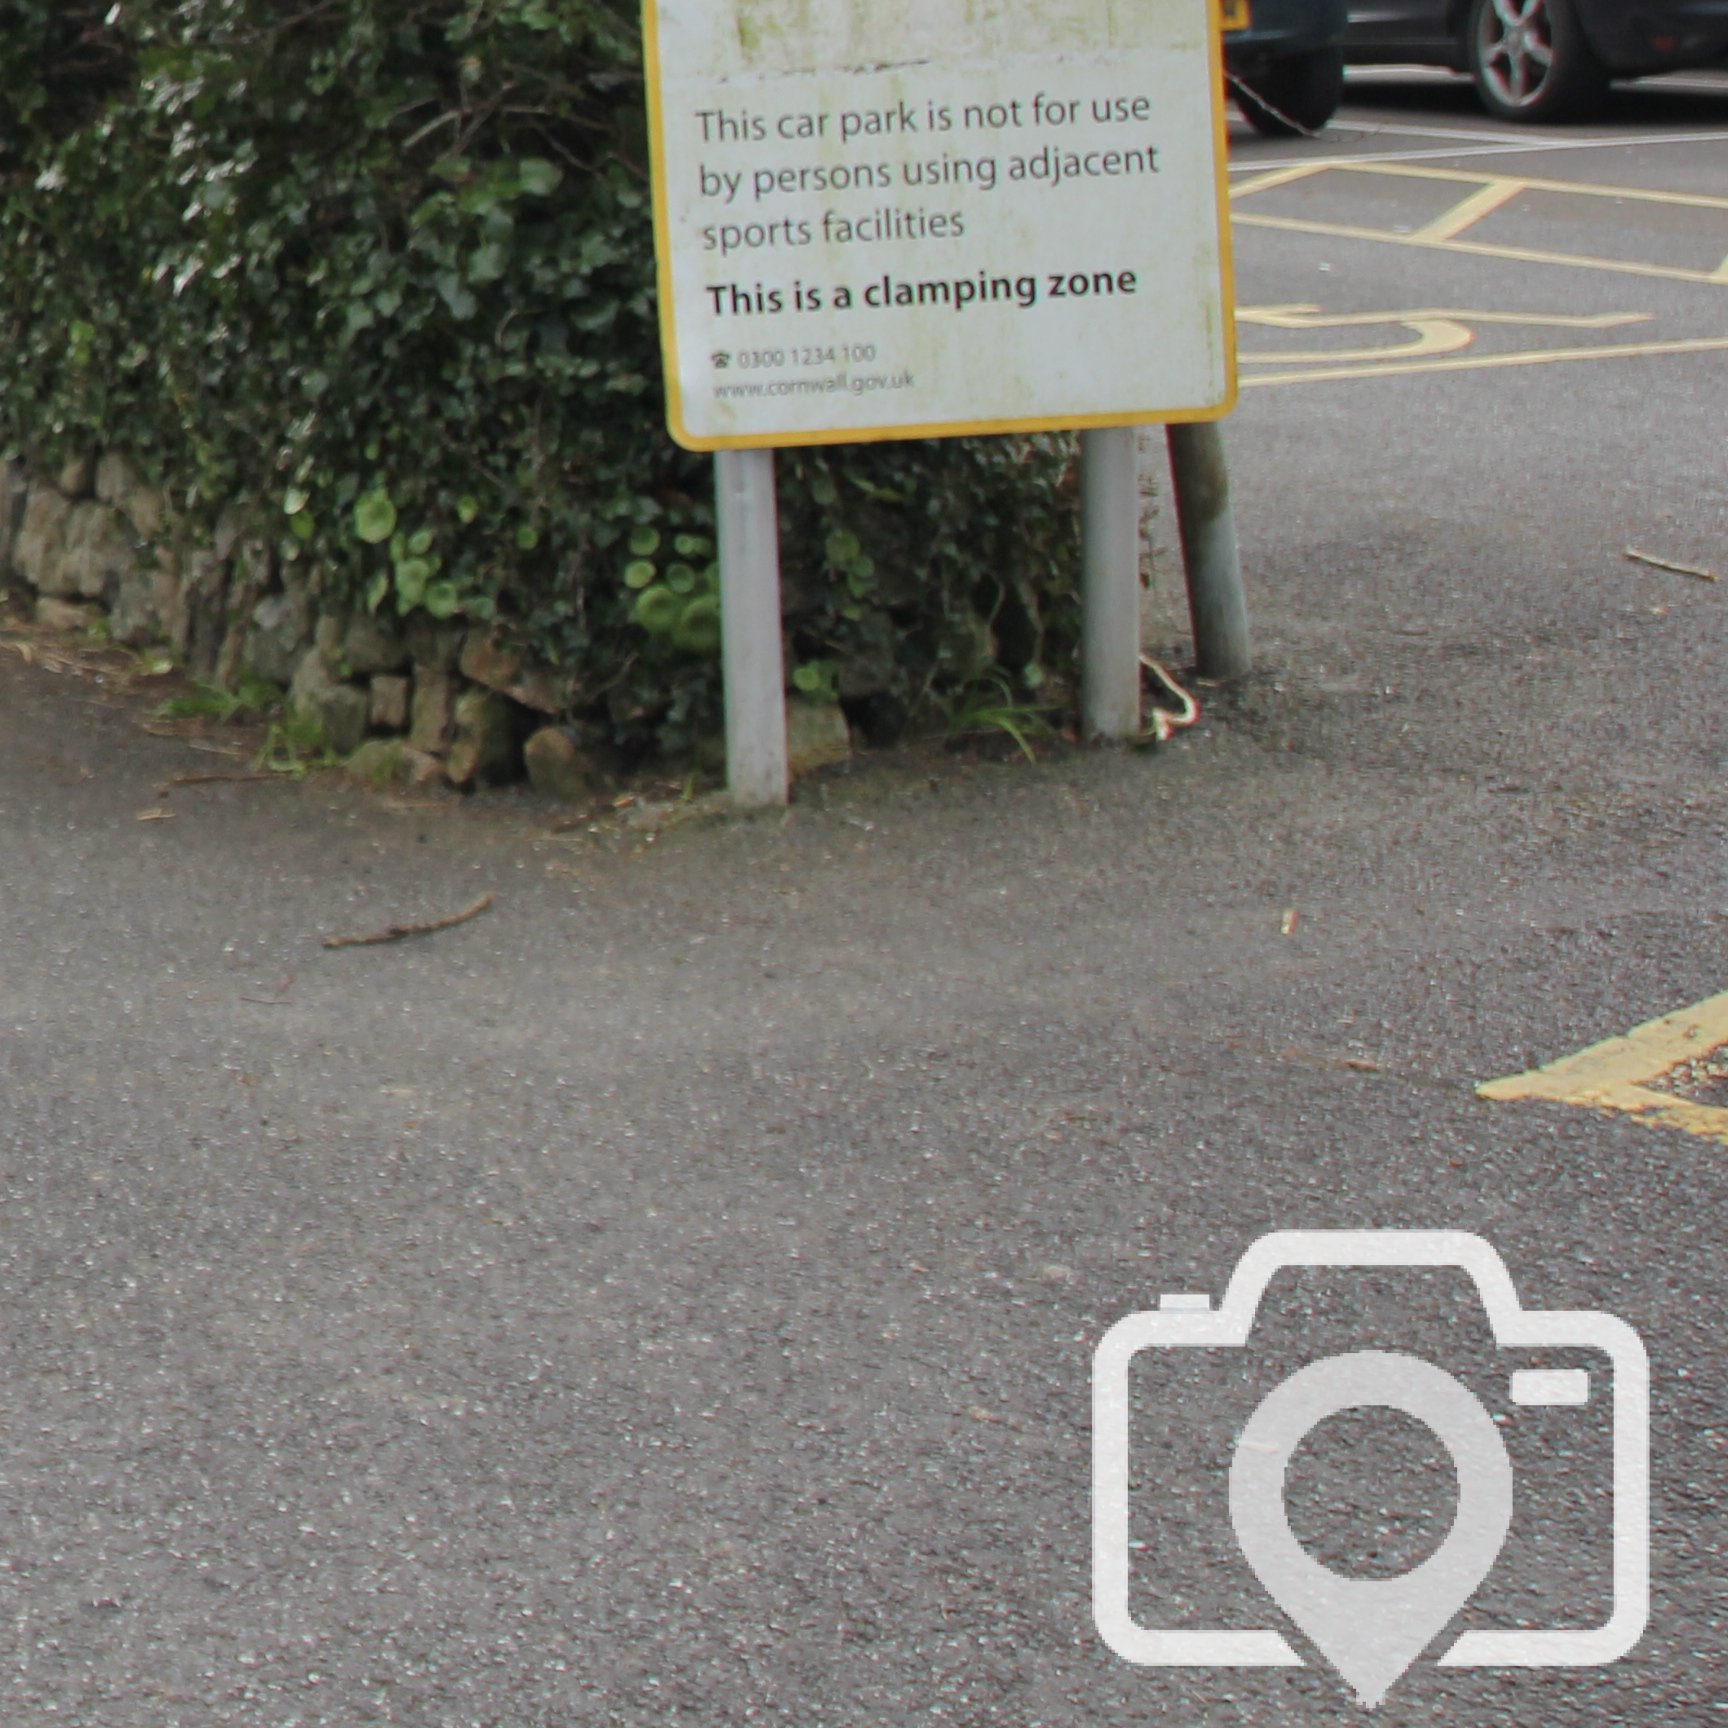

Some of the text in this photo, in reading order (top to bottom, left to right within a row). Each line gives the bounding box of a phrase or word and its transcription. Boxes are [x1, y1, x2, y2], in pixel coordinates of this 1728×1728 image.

[695, 92, 1150, 143] This car park is not for use
[699, 145, 1159, 203] by persons using adjacent
[702, 208, 964, 256] sports facilities
[706, 270, 1136, 314] This is a clamping zone
[736, 343, 876, 368] 0300 1234 100
[712, 370, 914, 397] www.cornwall.gov.uk
